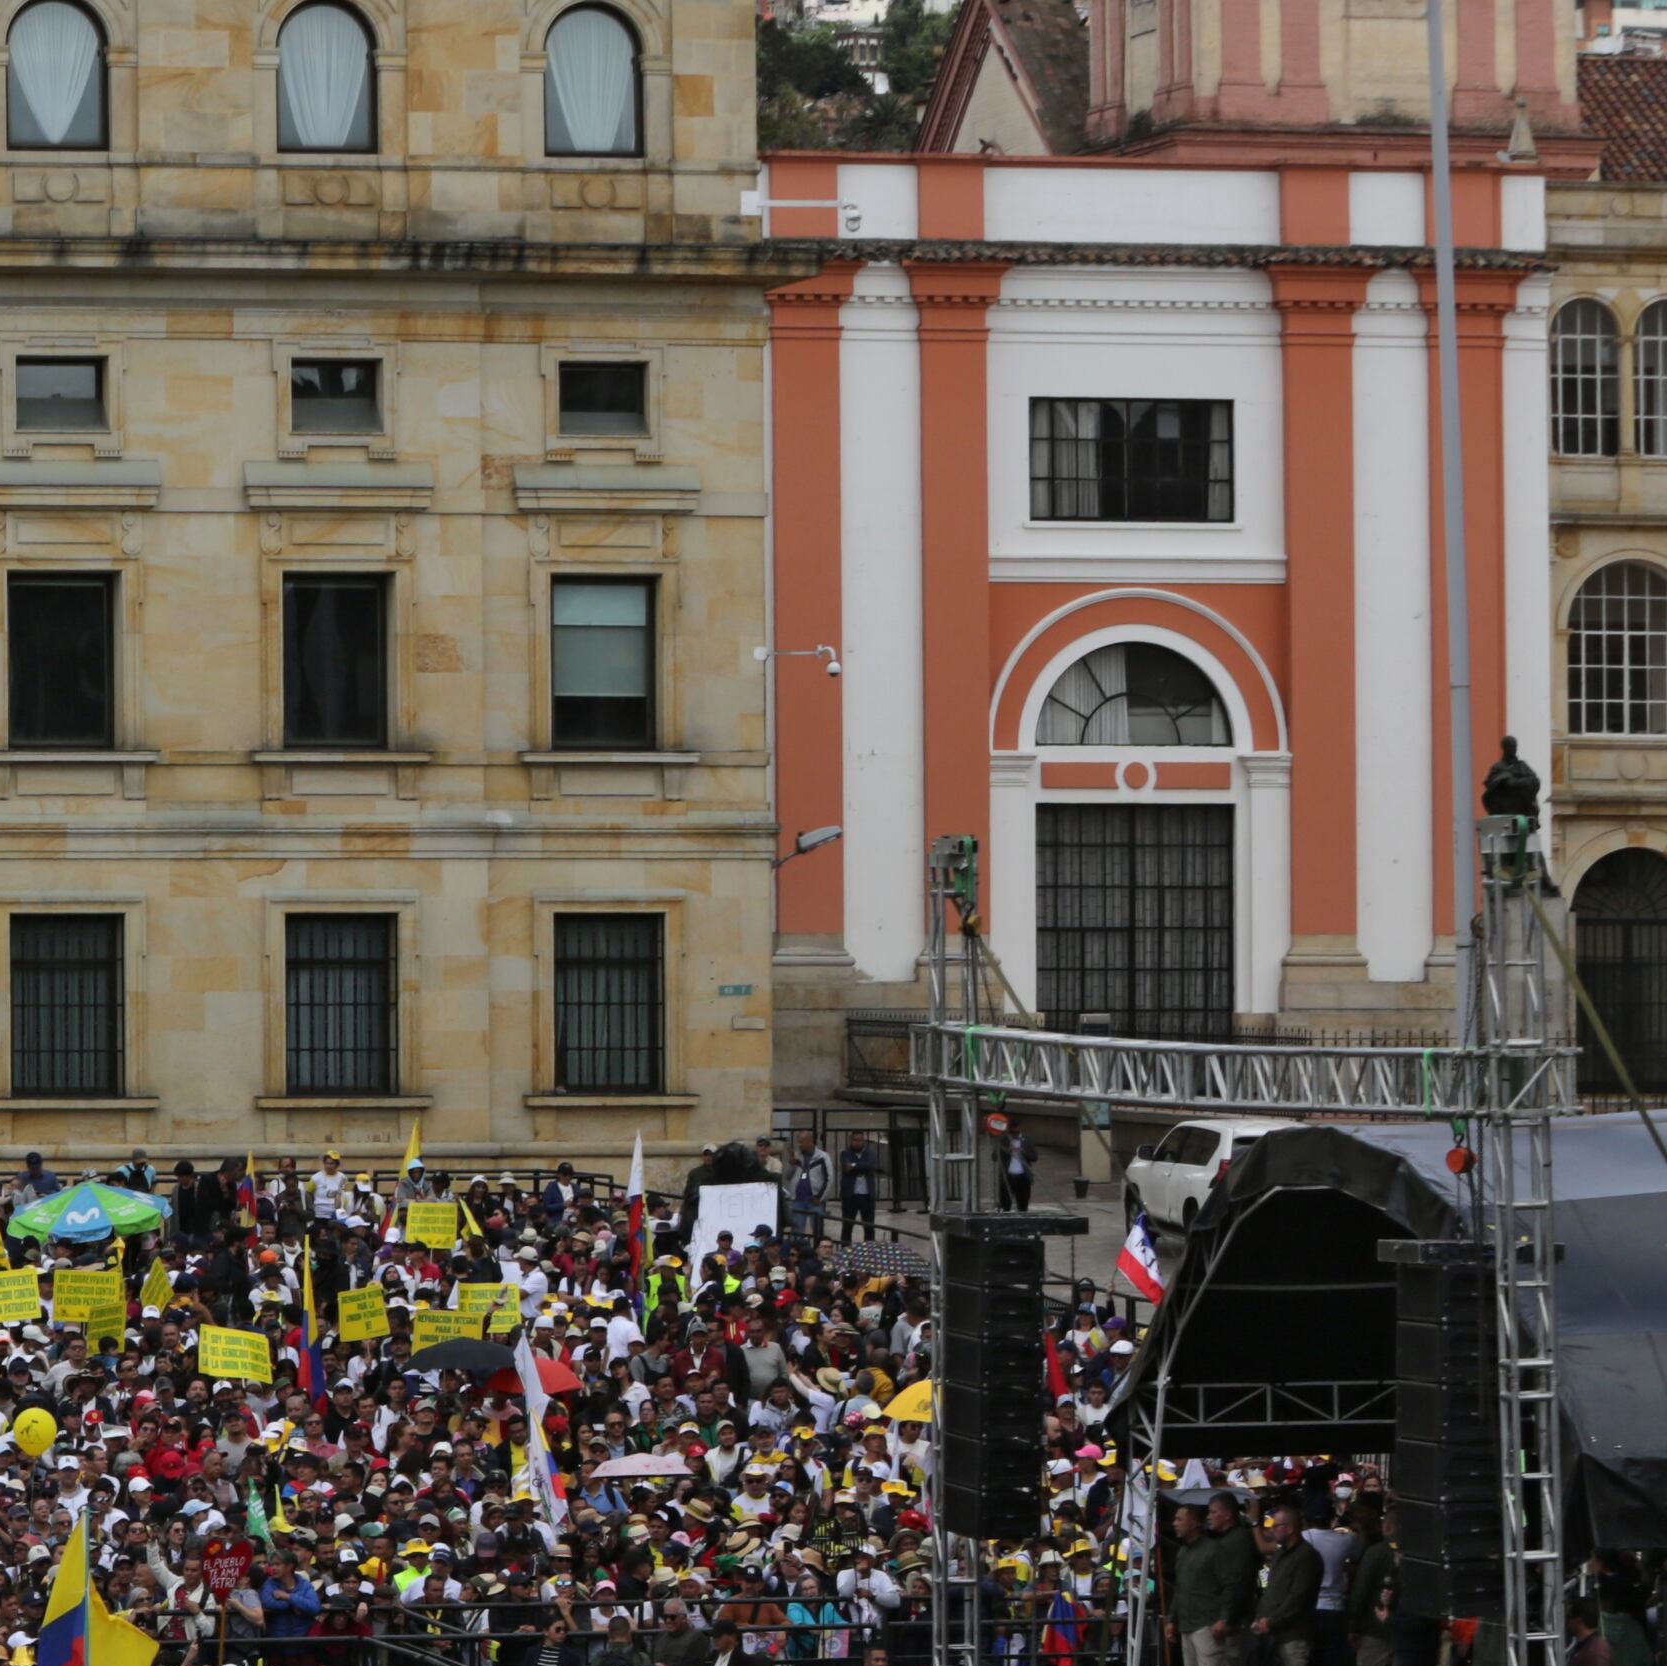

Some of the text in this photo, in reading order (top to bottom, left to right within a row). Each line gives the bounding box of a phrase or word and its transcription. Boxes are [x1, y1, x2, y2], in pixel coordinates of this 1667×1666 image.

[203, 1556, 245, 1570] EL PUEBLO
[208, 1568, 239, 1579] TE AMA
[210, 1577, 236, 1589] PETRO
